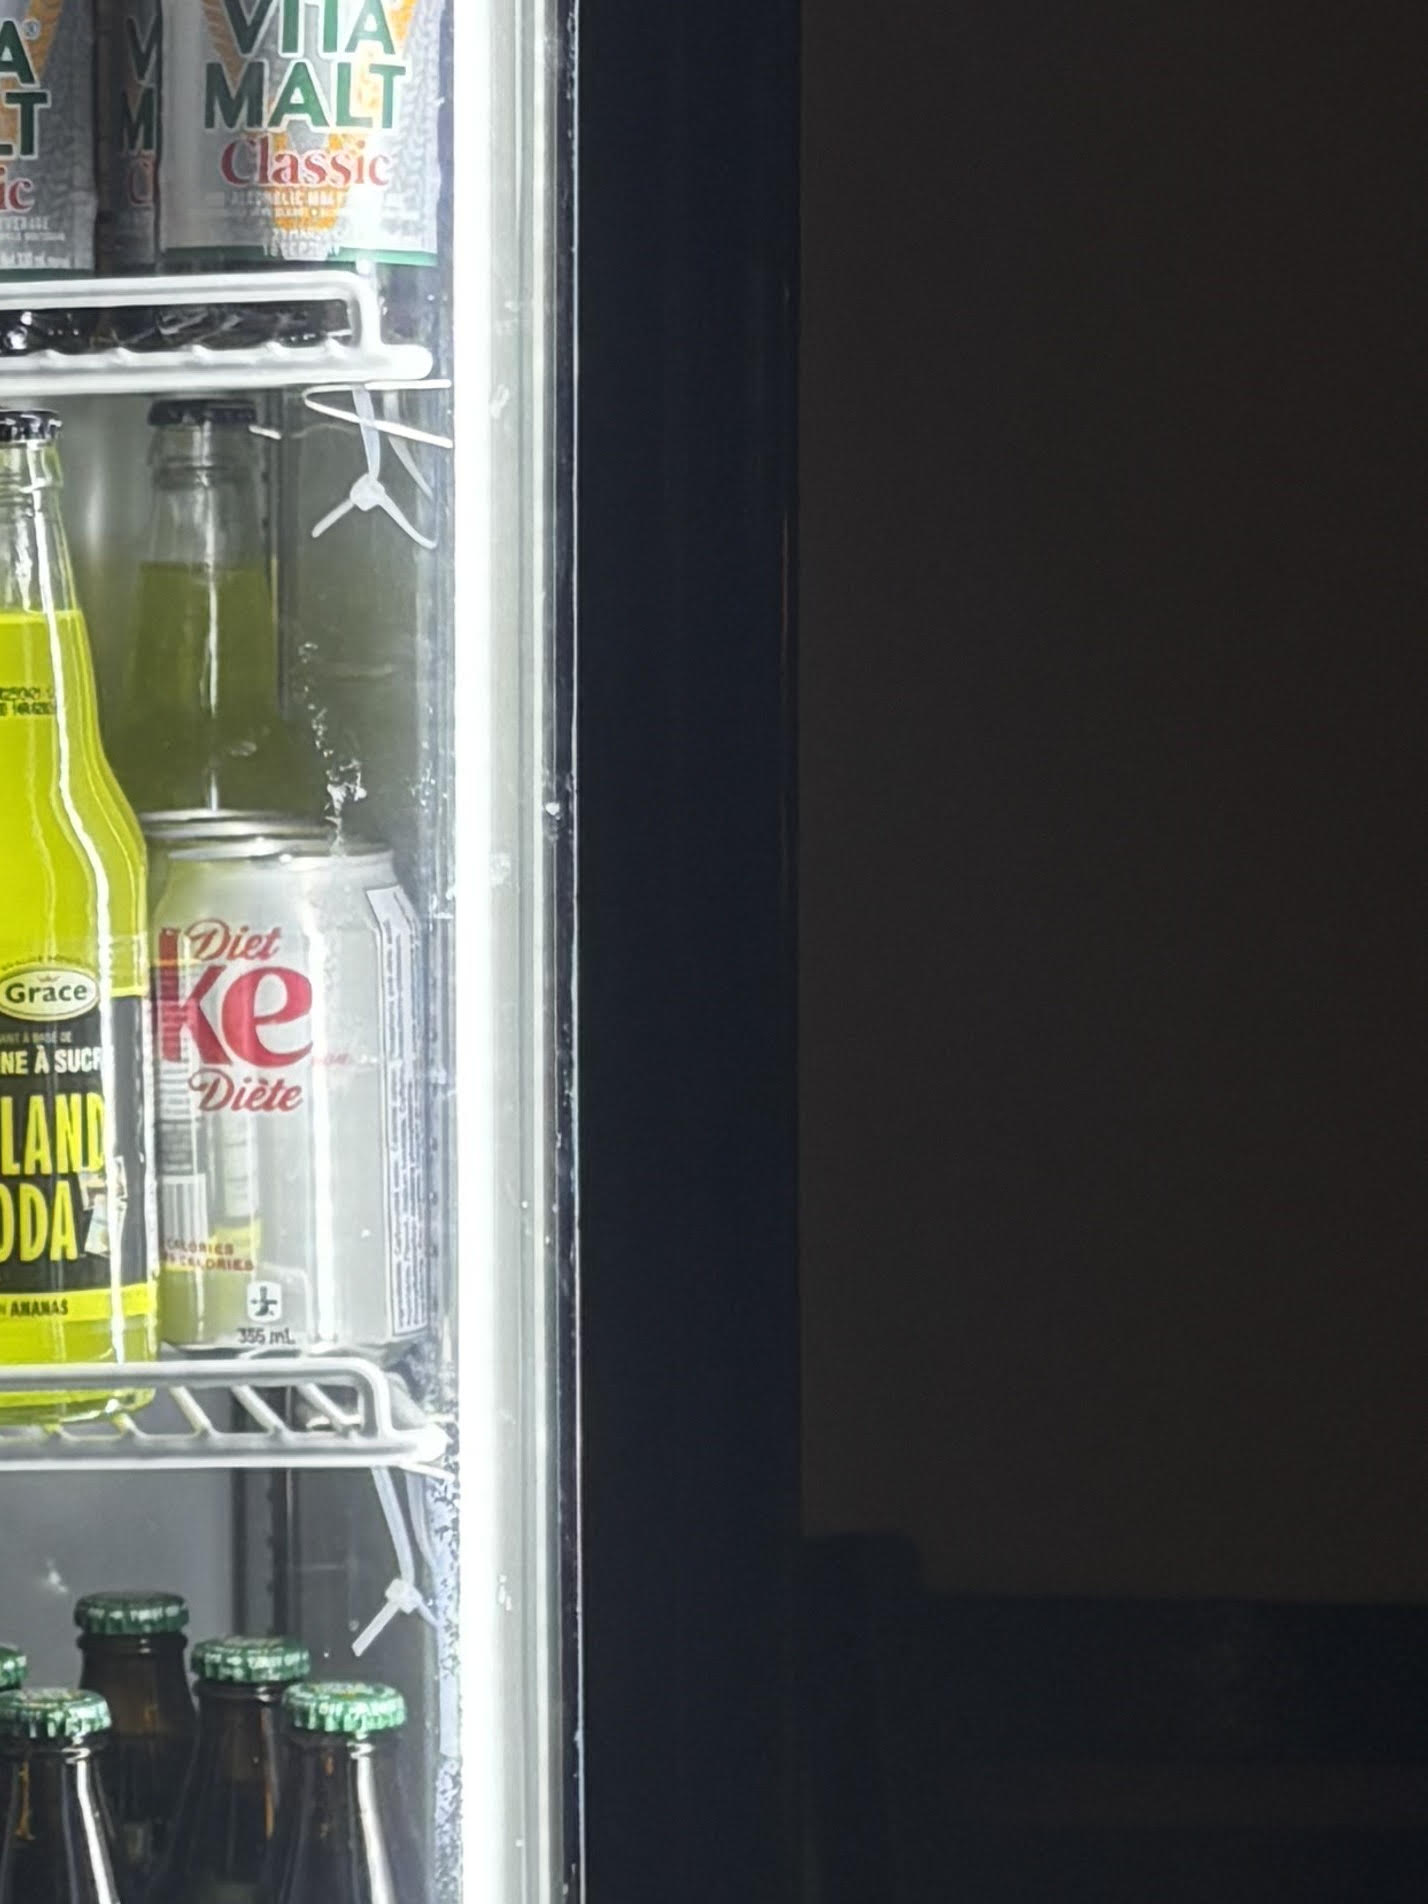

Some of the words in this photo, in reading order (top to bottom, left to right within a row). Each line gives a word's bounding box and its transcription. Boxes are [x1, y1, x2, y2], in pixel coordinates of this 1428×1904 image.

[203, 60, 408, 131] MALT
[219, 139, 391, 186] Classic
[188, 916, 283, 962] Diet
[4, 981, 89, 1005] Grace
[158, 926, 315, 1069] ke
[33, 1043, 50, 1075] À
[188, 1066, 305, 1114] Diète
